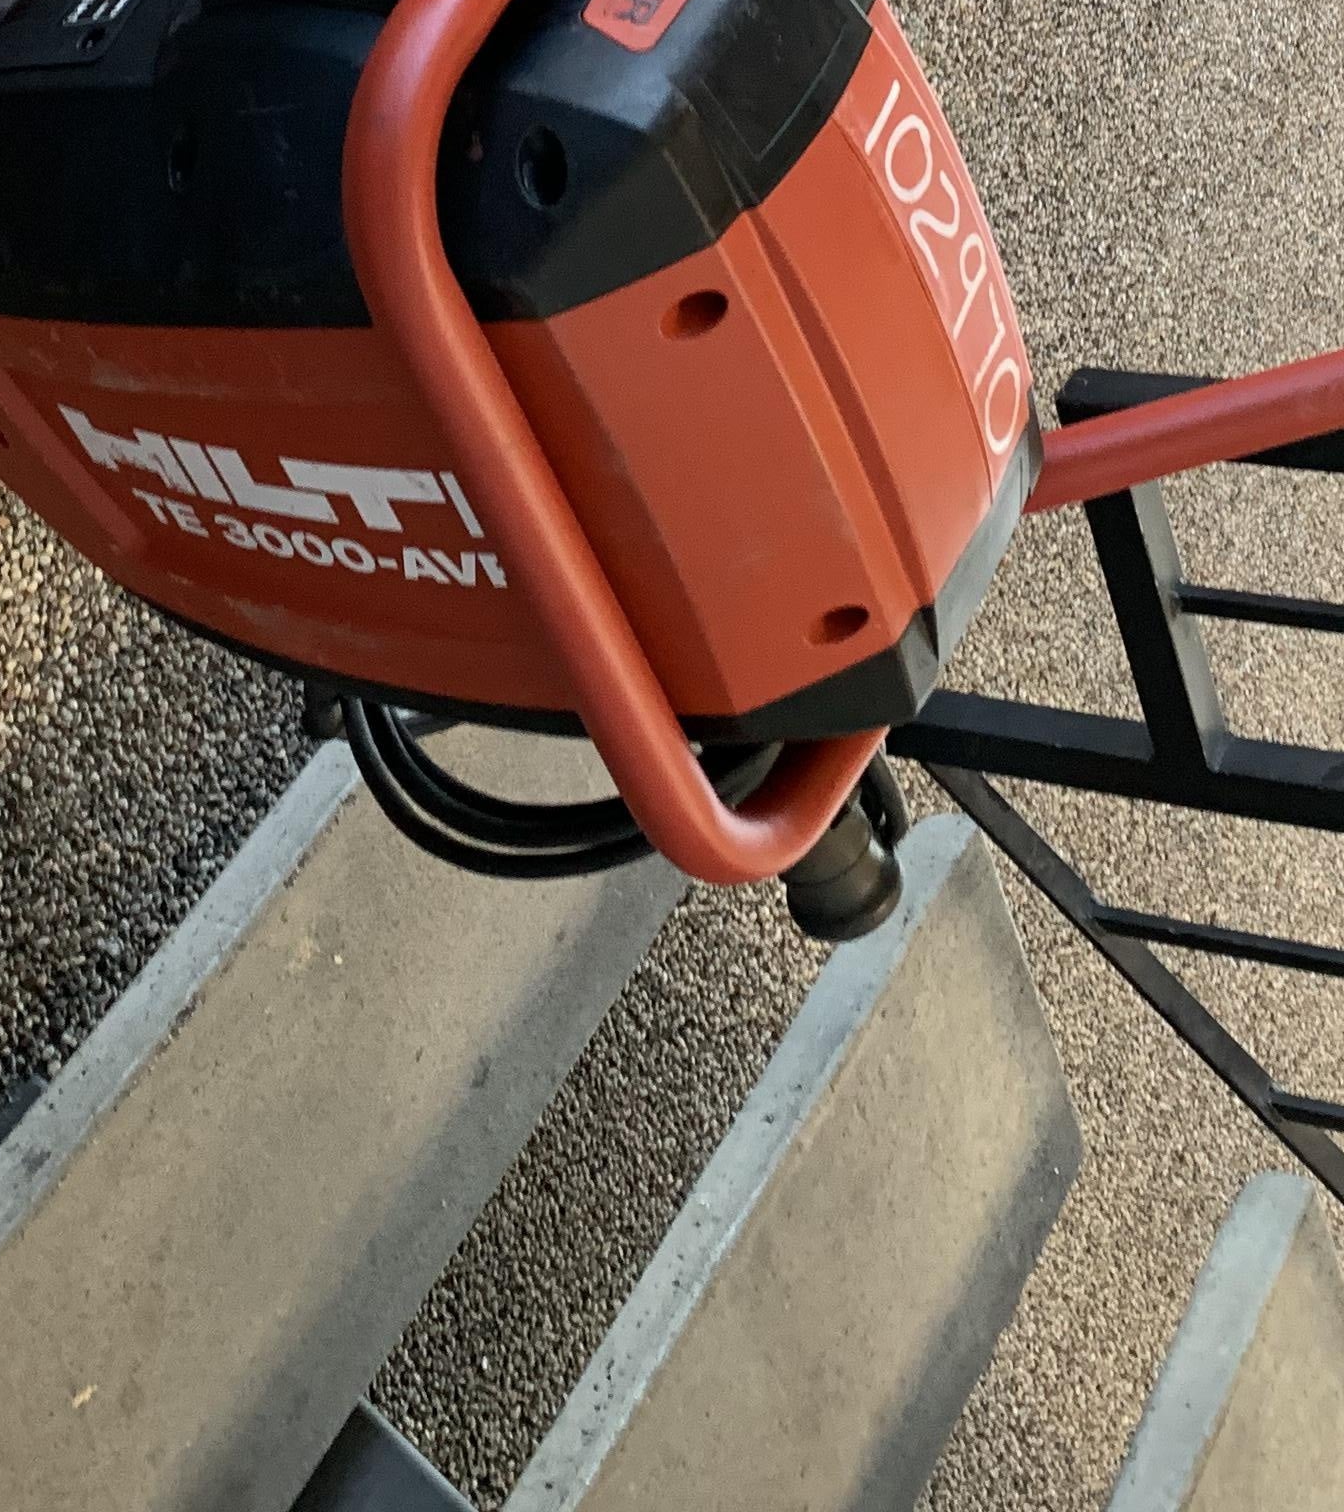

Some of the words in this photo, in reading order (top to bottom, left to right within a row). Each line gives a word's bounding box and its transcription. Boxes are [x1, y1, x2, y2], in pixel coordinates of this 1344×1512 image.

[864, 79, 1021, 455] 102970
[57, 403, 484, 539] HILTI
[132, 487, 209, 538] TE
